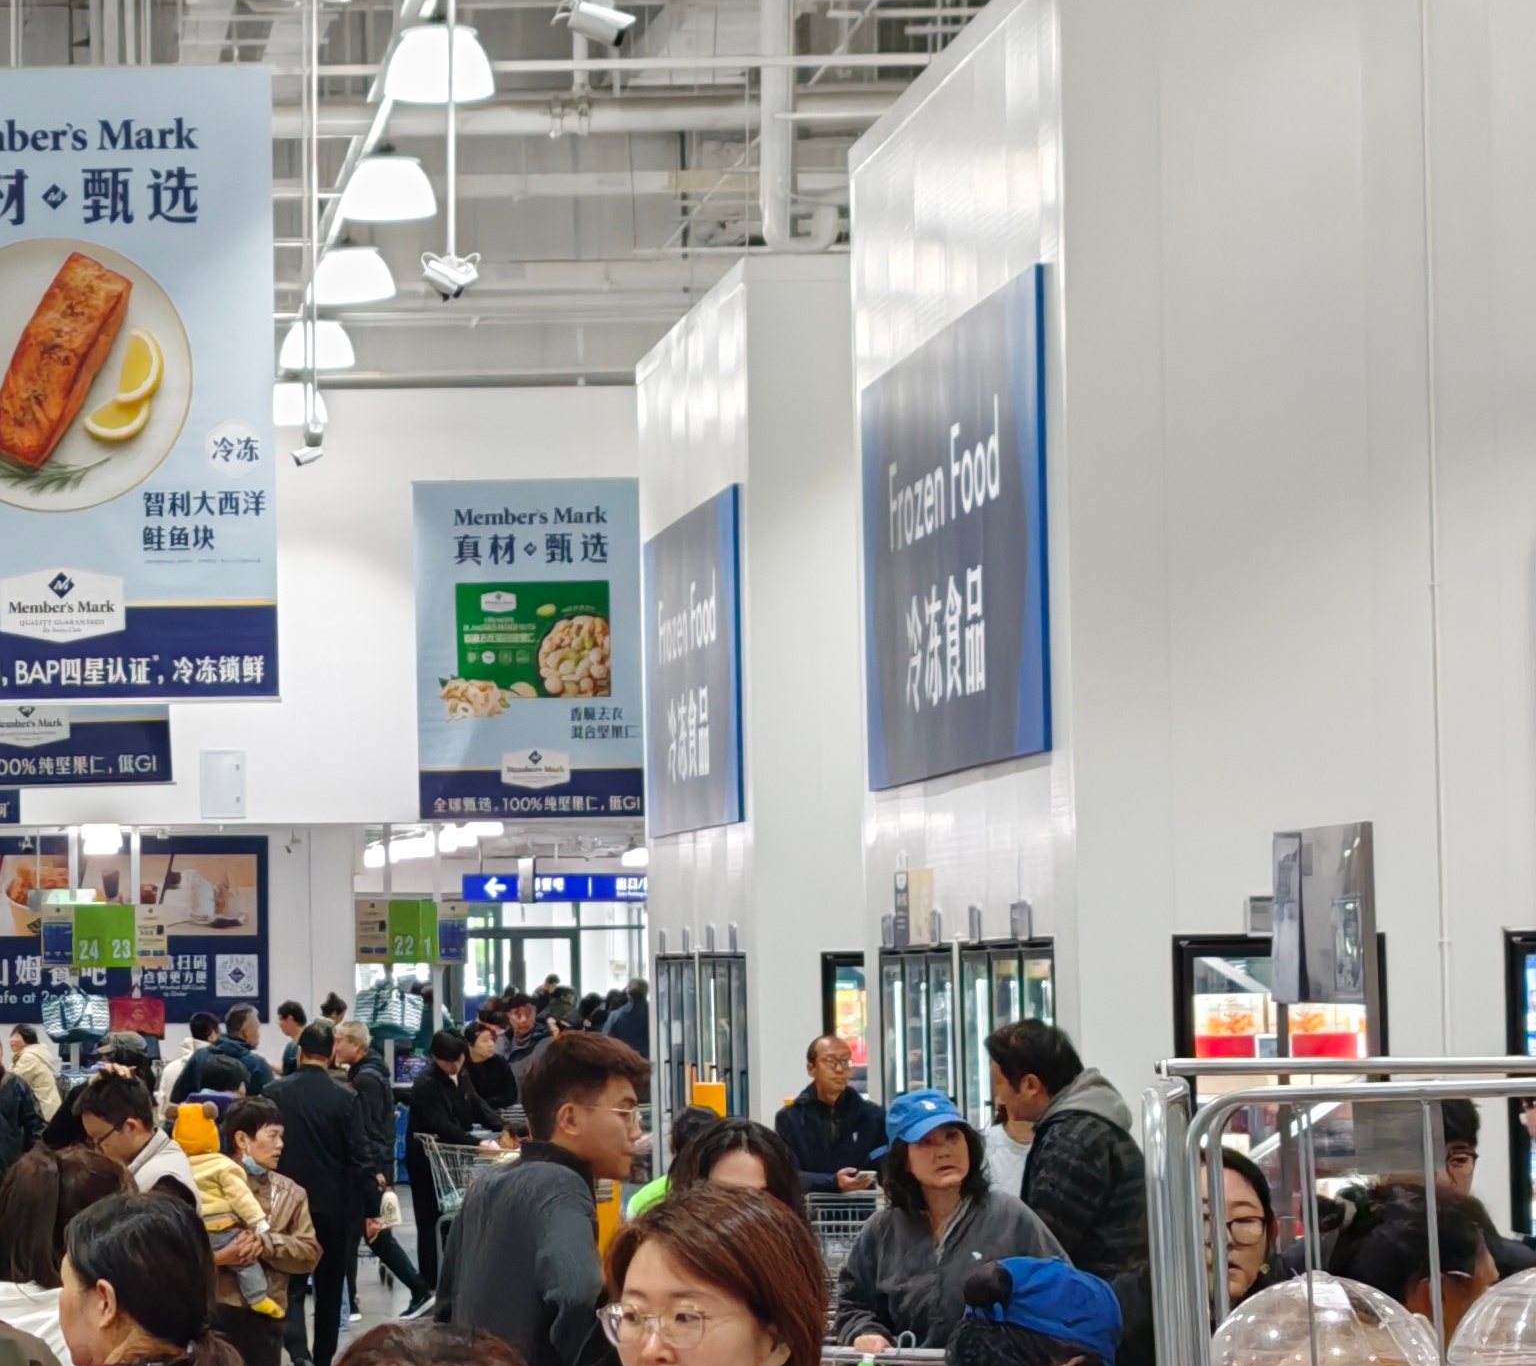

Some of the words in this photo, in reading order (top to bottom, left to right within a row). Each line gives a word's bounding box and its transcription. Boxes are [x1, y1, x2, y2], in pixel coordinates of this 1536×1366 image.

[97, 117, 199, 151] Mark
[81, 166, 199, 224] 甄选
[212, 436, 260, 463] 冷冻
[888, 461, 945, 553] Frozen
[950, 393, 1000, 521] Food
[143, 490, 267, 517] 智利大西洋
[453, 507, 548, 527] Member's
[553, 505, 608, 525] Mark
[142, 525, 215, 552] 鲑鱼块
[453, 533, 517, 567] 真材
[545, 532, 609, 565] 甄选
[8, 600, 74, 614] Member's
[77, 600, 116, 613] Mark
[658, 600, 689, 665] Frozen
[690, 566, 717, 650] Food
[906, 564, 986, 714] 冷冻食品
[667, 685, 710, 784] 冷冻食品
[79, 939, 99, 960] 24
[112, 938, 132, 959] 23
[394, 935, 415, 956] 22
[22, 992, 37, 1004] at
